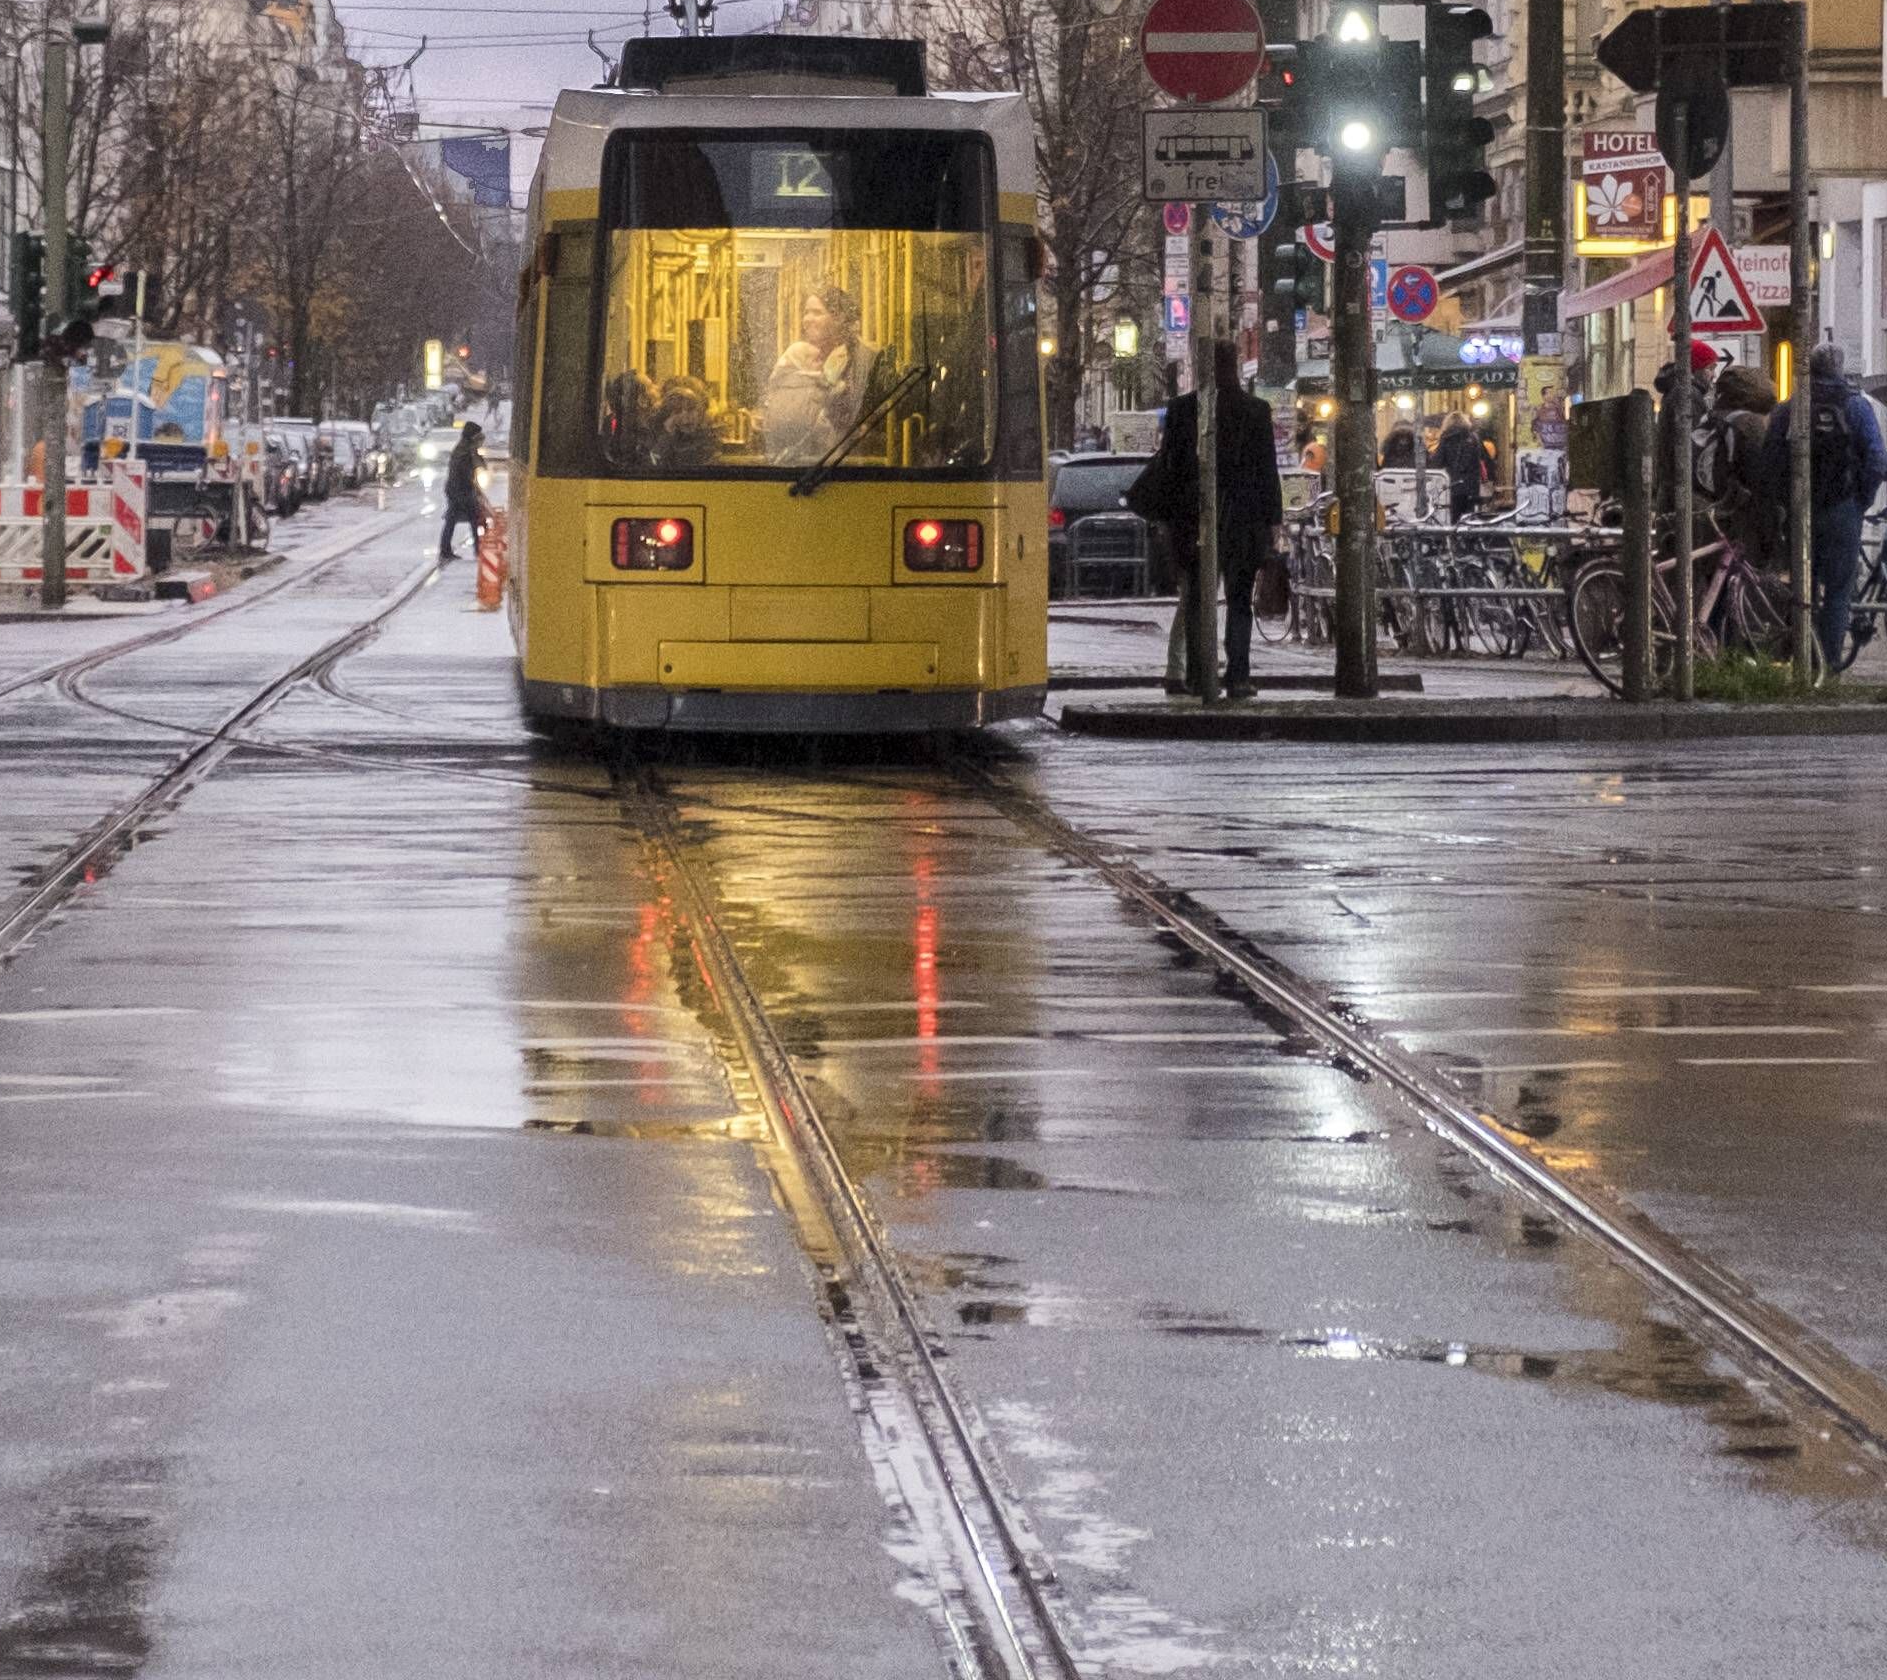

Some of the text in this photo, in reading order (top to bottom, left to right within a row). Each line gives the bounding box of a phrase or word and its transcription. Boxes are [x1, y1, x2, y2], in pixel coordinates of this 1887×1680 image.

[1593, 133, 1657, 152] HOTEL
[777, 151, 825, 196] 12
[1451, 370, 1504, 384] SALAD
